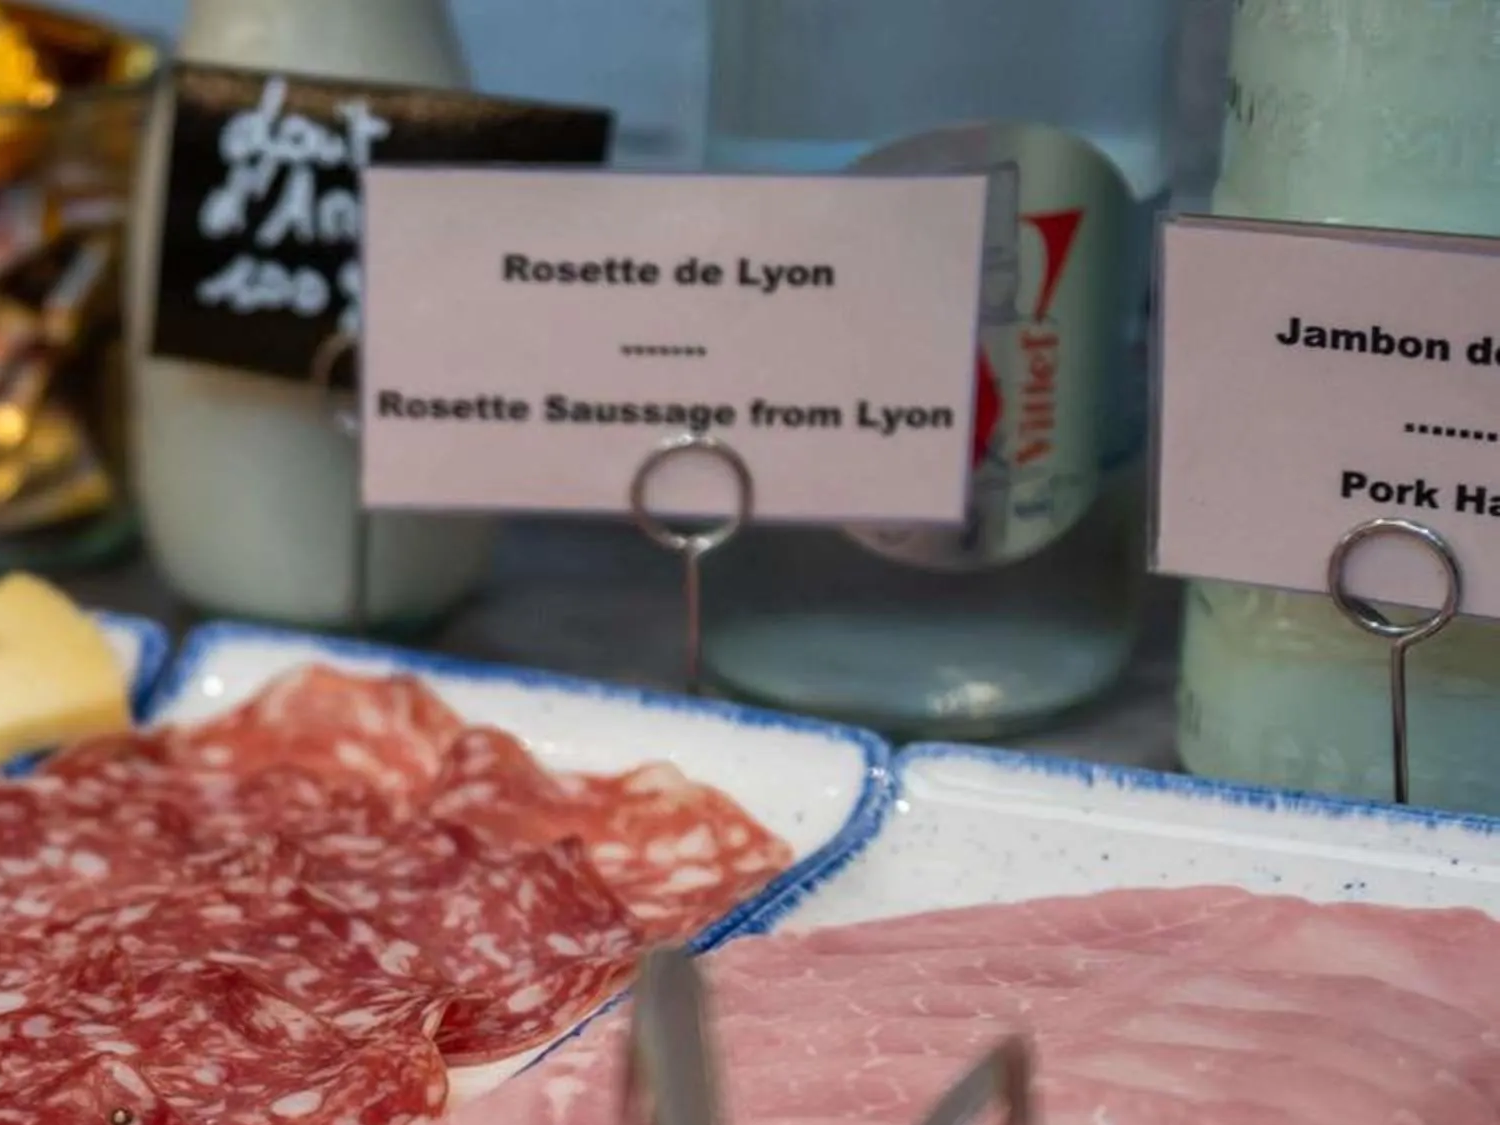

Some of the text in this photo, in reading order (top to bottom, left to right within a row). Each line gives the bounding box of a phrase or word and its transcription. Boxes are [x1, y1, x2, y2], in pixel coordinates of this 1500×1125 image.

[502, 252, 836, 295] Rosette de Lyon
[1274, 315, 1500, 368] Jambon d
[376, 389, 955, 437] Rosette Saussage from Lyon
[1339, 469, 1441, 511] Pork
